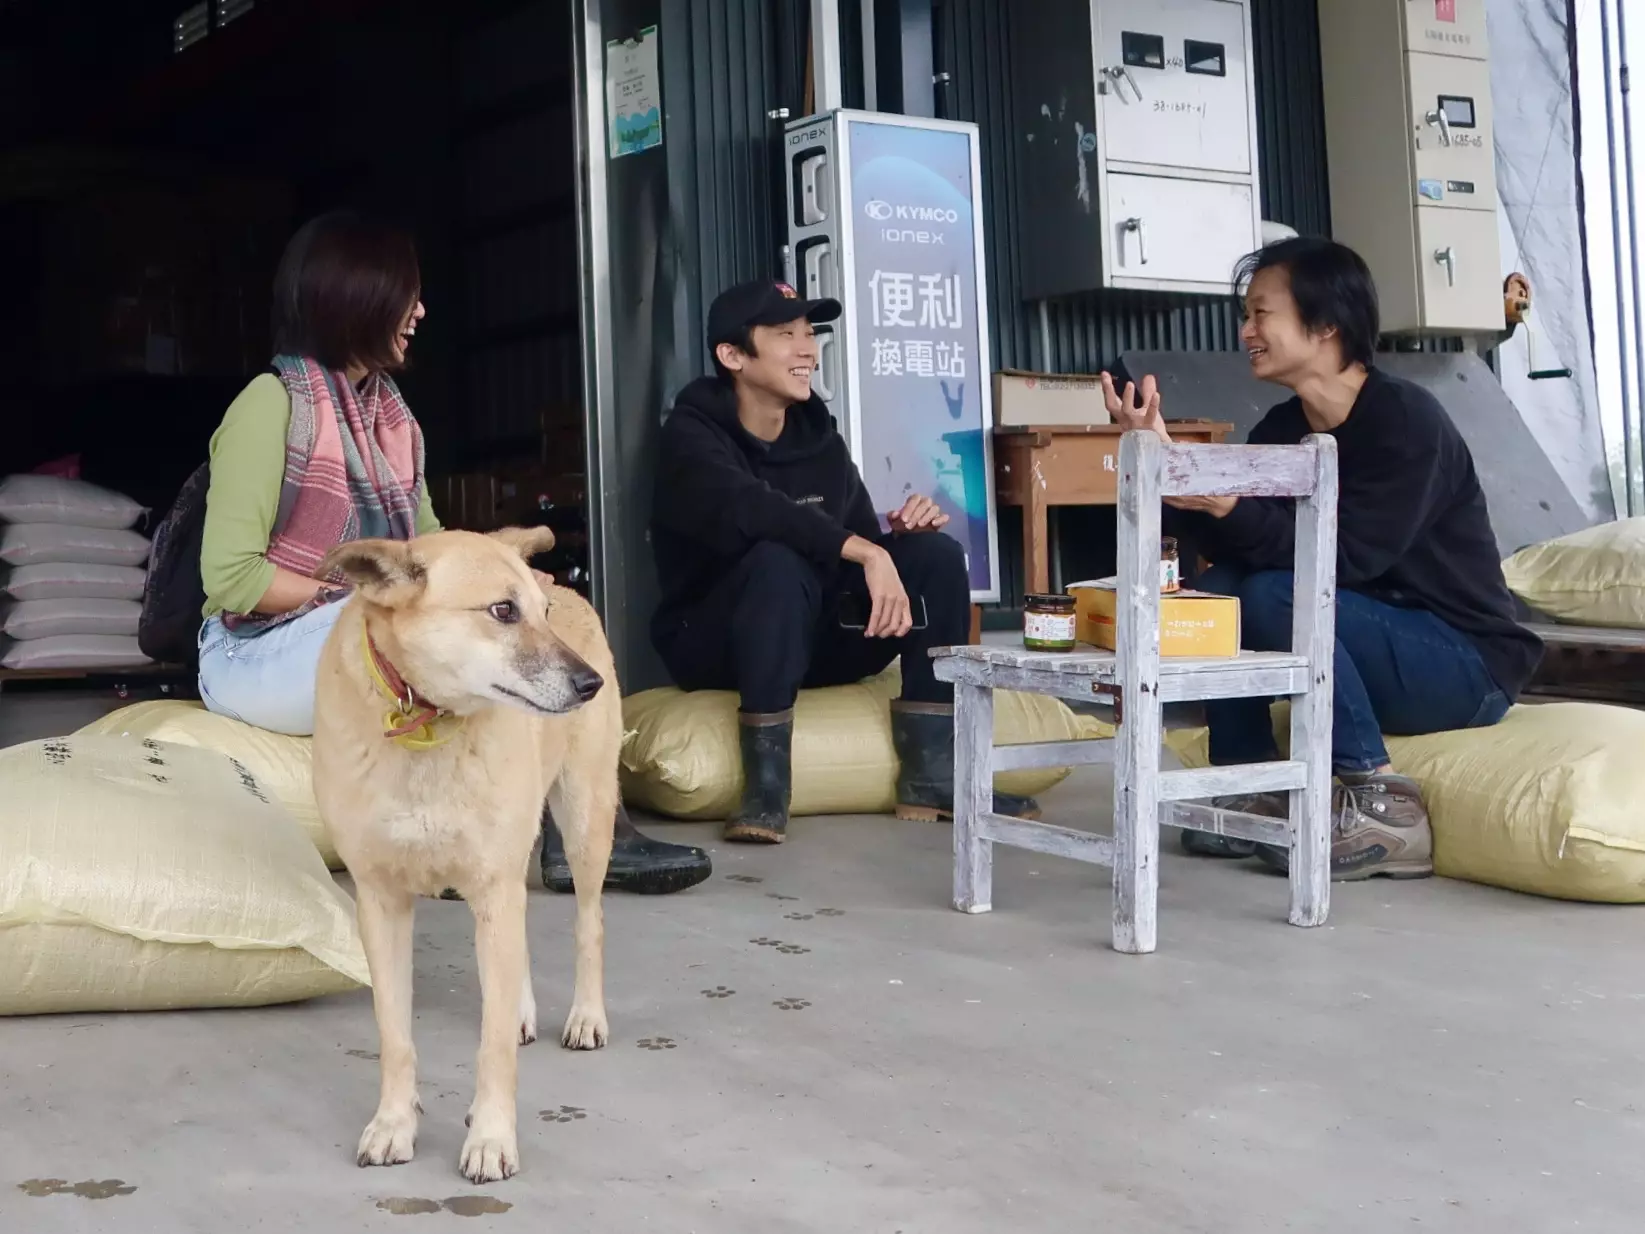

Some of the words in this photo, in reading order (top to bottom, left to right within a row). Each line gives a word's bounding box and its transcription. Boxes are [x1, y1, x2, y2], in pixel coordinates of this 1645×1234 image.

[788, 127, 827, 146] ionex
[896, 205, 958, 224] KYMCO
[881, 228, 945, 246] ionex
[868, 269, 963, 330] 便利
[871, 338, 966, 378] 換電站
